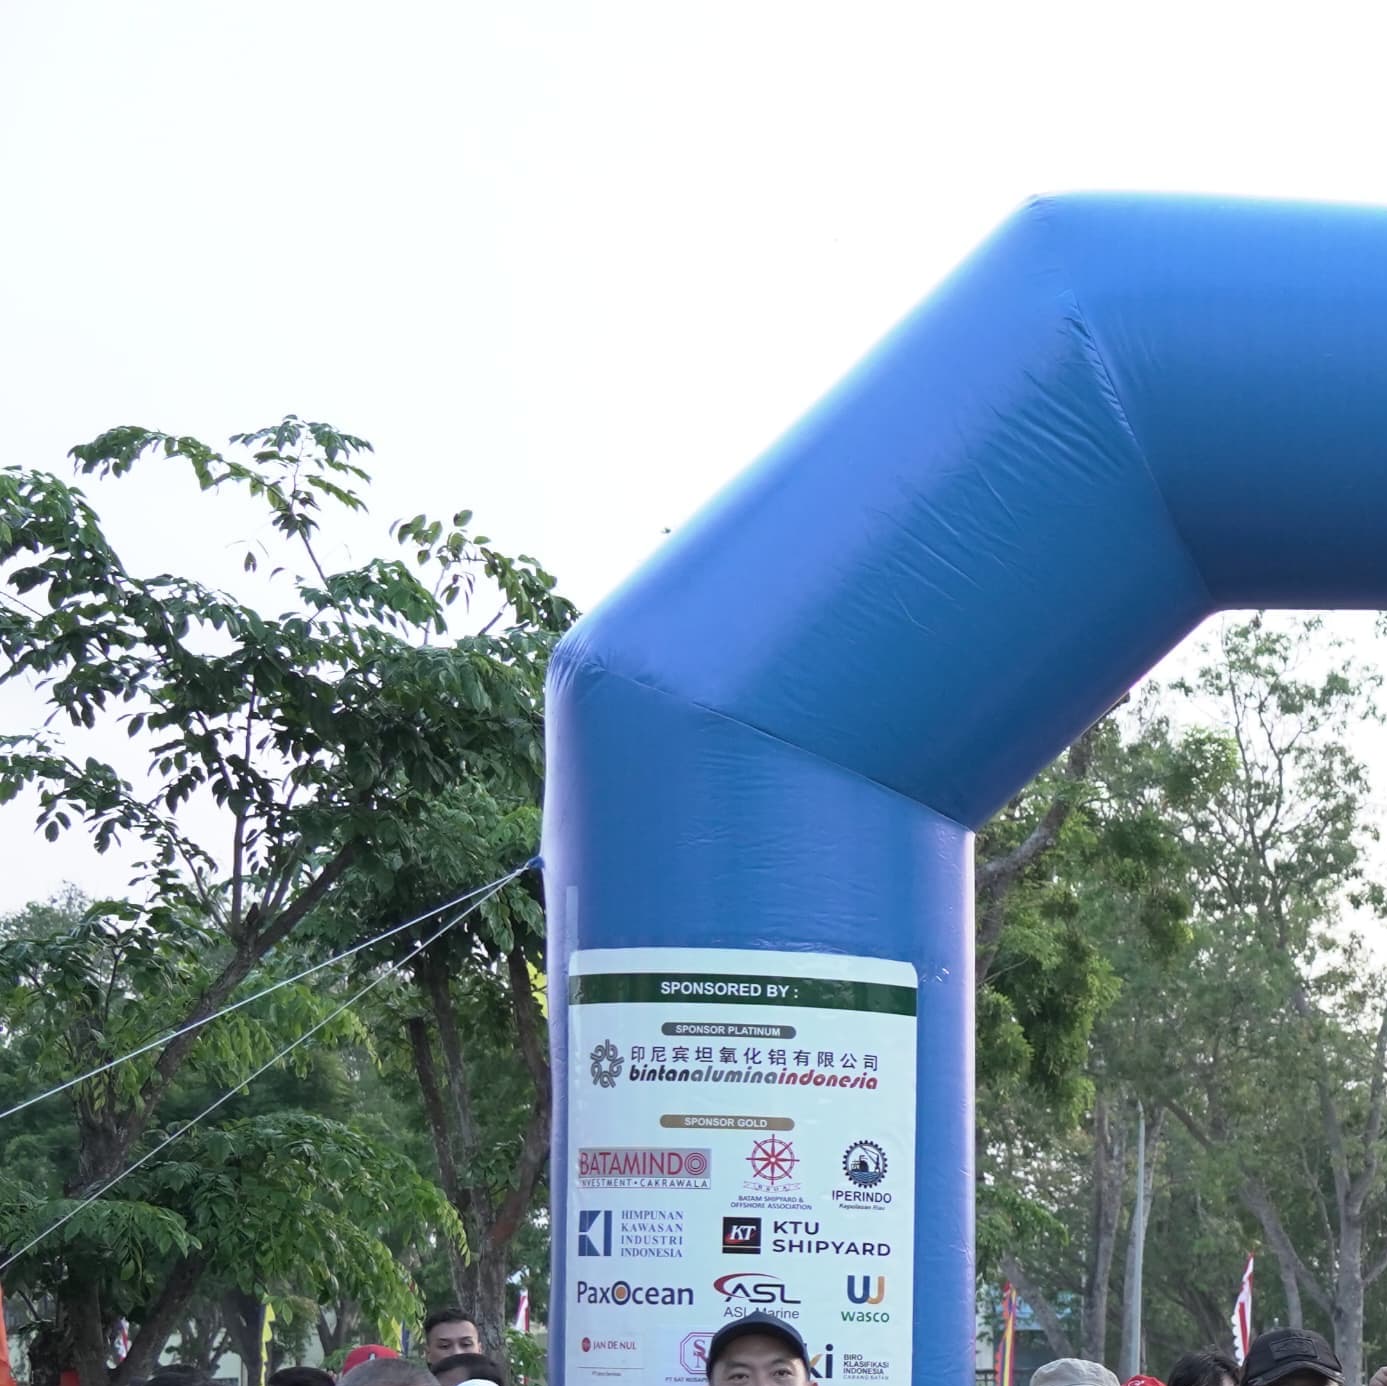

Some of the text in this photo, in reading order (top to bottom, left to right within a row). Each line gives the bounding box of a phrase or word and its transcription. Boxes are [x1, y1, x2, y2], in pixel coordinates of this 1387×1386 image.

[661, 982, 761, 997] SPONSORED
[767, 985, 790, 998] BY
[676, 1025, 781, 1037] SPONSOR PLATINUM
[631, 1045, 878, 1072] 印尼宾坦氧化铝有限公司
[629, 1064, 878, 1090] bintanaluminaindonesia
[684, 1117, 767, 1129] SPONSOR GOLD
[580, 1152, 708, 1176] BATAMINDO
[580, 1179, 708, 1188] NVESTMENT CAKRAWALA
[832, 1190, 892, 1204] IPERINDO
[621, 1210, 684, 1220] HIMPUNAN
[621, 1223, 684, 1233] KAWASAN
[729, 1225, 757, 1241] KT
[773, 1221, 820, 1235] KTU
[621, 1235, 683, 1245] INDUSTRI
[620, 1247, 683, 1258] INDONESIA
[772, 1239, 891, 1257] SHIPYARD
[577, 1280, 694, 1305] PaxOcean
[841, 1311, 890, 1323] wasco
[593, 1340, 637, 1350] JAN DE NUL
[843, 1367, 884, 1375] INDONESIA
